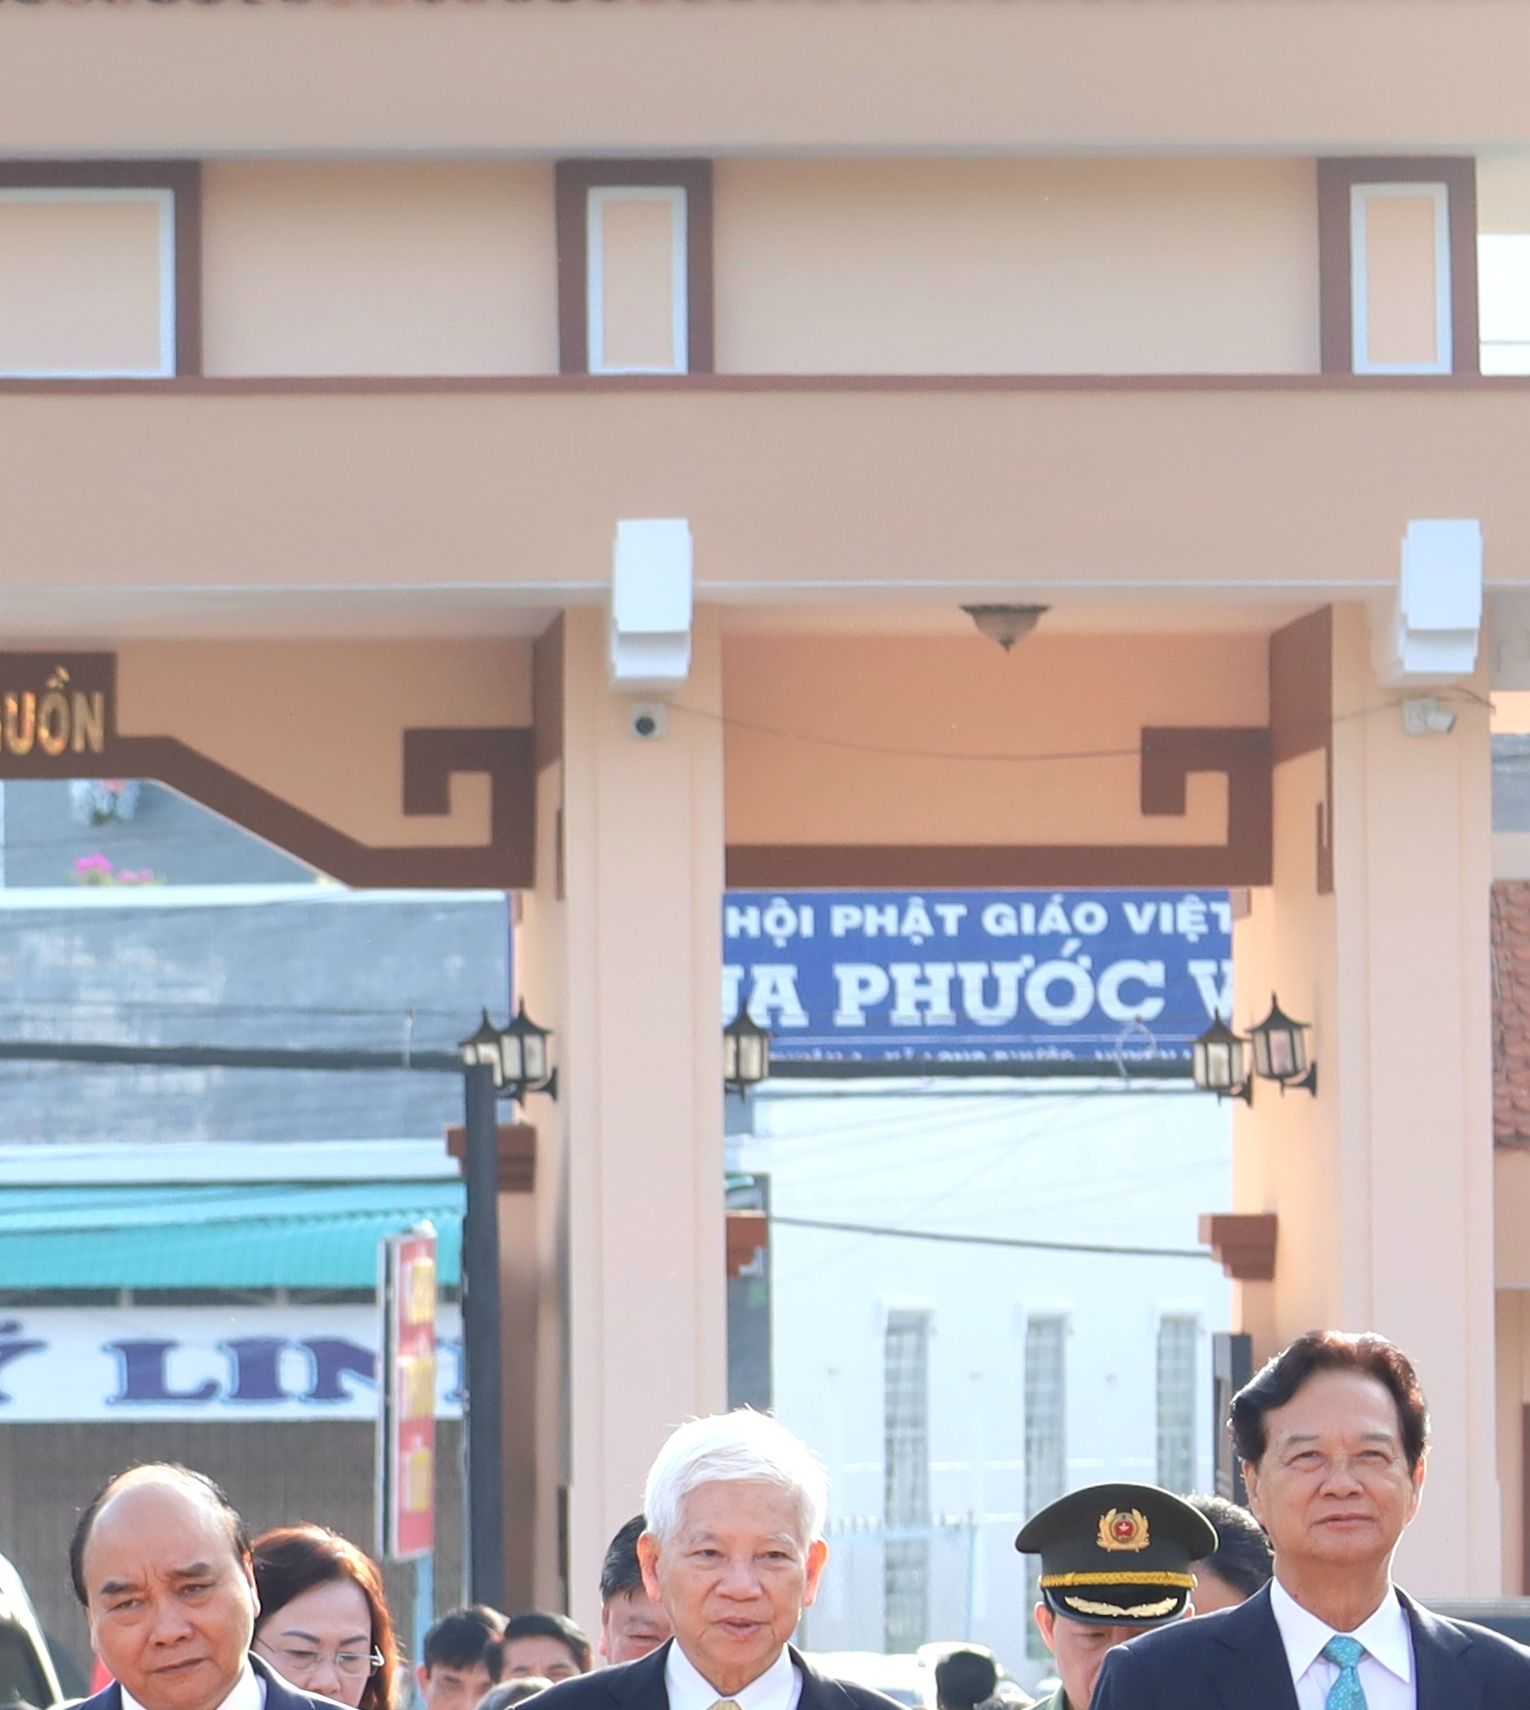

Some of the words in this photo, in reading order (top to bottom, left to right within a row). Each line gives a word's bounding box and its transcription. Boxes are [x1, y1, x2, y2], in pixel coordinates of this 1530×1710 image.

[829, 894, 968, 946] PHẬT
[981, 894, 1109, 936] GIÁO
[832, 940, 1167, 1028] PHƯỚC
[104, 1335, 465, 1406] LIN
